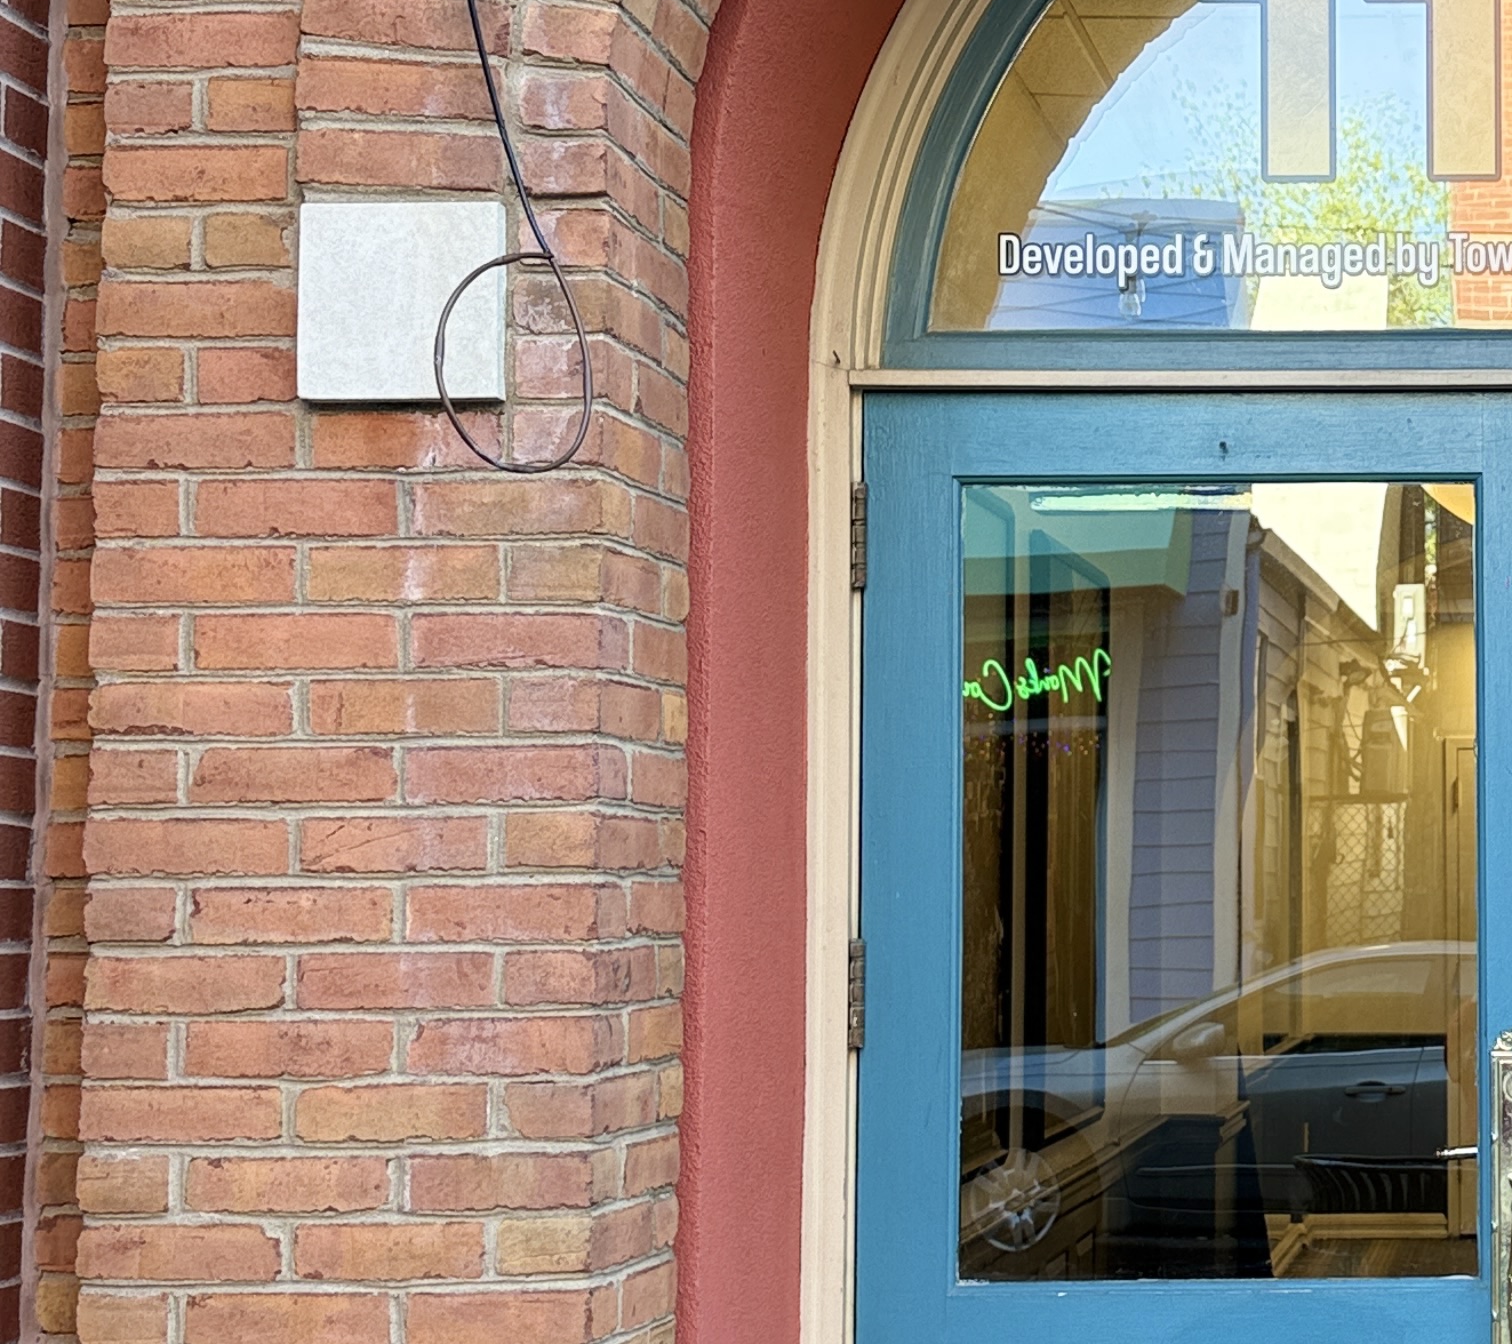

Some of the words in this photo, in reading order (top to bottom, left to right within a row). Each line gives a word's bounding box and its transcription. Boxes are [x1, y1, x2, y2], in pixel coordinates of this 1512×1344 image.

[998, 232, 1184, 290] Developed
[1193, 233, 1214, 277] &
[1222, 232, 1387, 289] Managed
[1396, 231, 1440, 287] by
